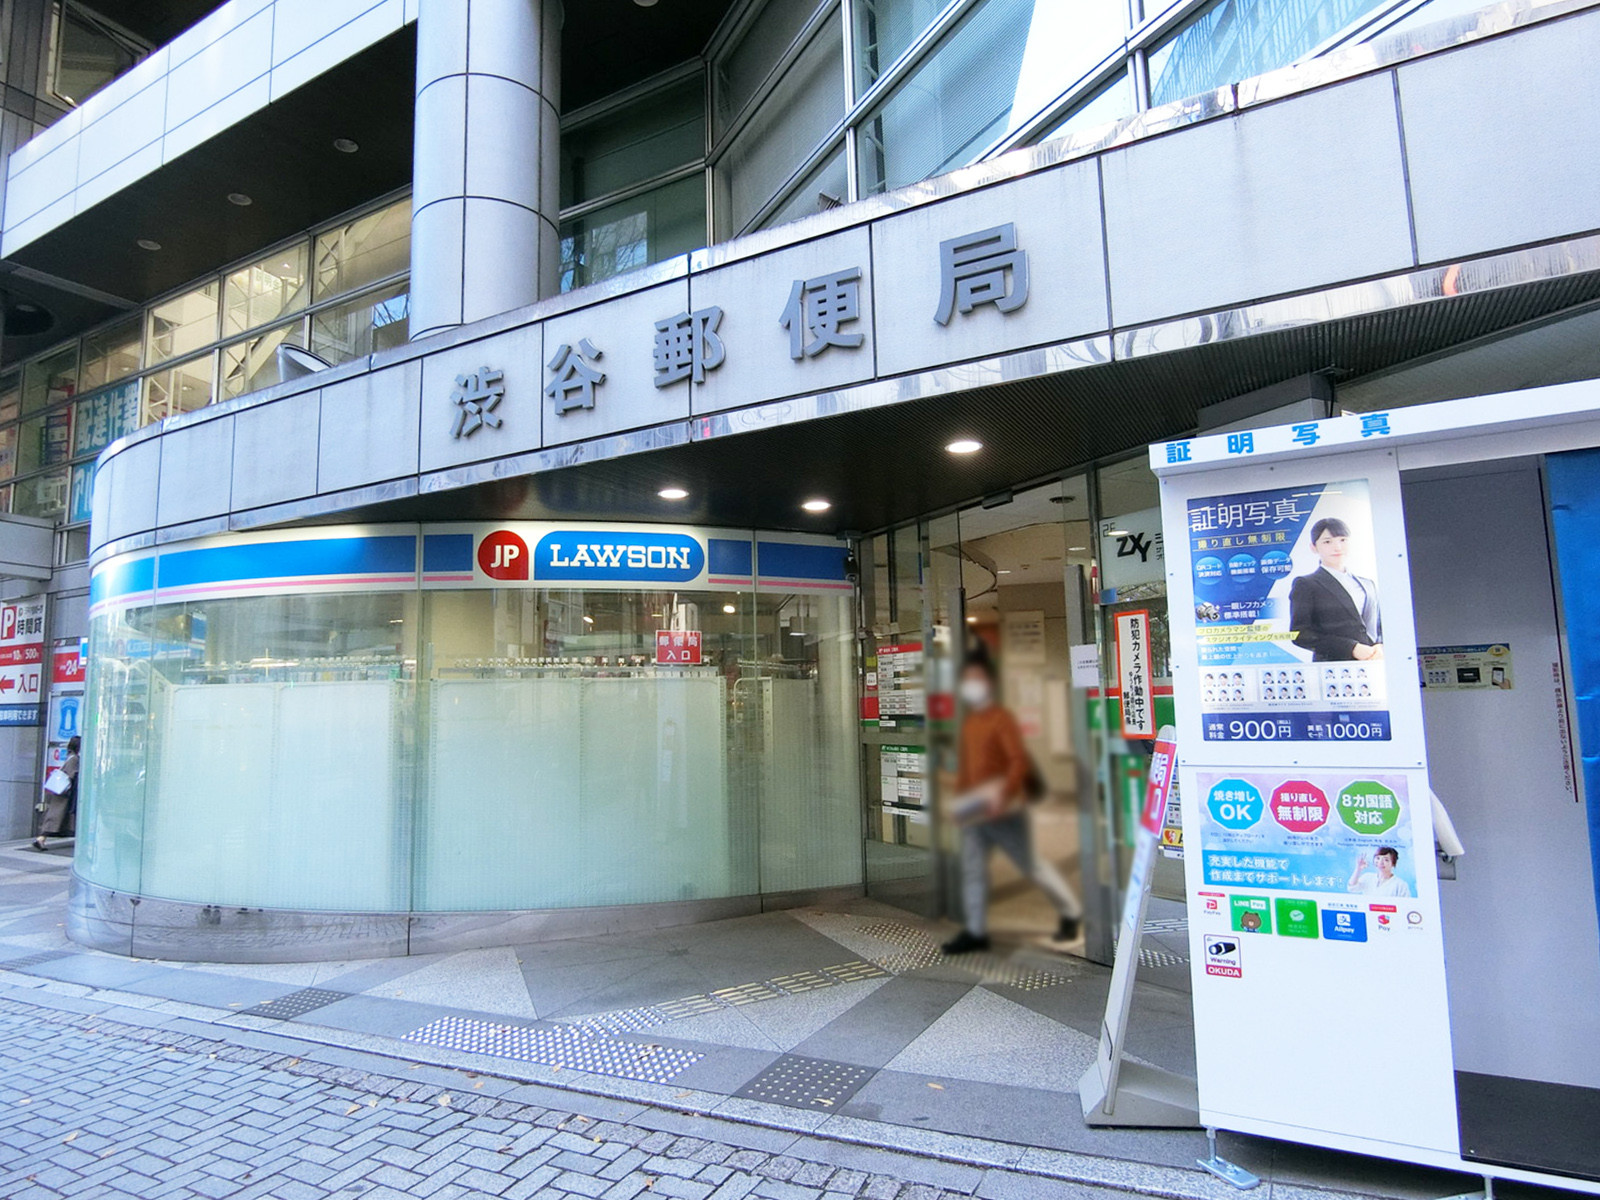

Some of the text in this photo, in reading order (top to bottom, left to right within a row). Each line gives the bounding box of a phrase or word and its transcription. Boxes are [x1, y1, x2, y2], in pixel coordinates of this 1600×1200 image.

[449, 222, 1030, 439] 渋谷郵便局
[1166, 412, 1391, 464] 証明写真
[1191, 498, 1300, 533] 証明写真
[1116, 532, 1152, 562] ZXY
[490, 544, 520, 568] JP
[550, 544, 691, 569] LAWSON
[2, 608, 14, 639] P
[658, 635, 698, 647] 郵便局
[666, 650, 691, 660] 入口
[1130, 618, 1145, 731] 防犯カメラ作動中です
[18, 673, 39, 694] 入口
[1229, 720, 1291, 740] 900円
[1326, 722, 1382, 739] 1000円
[1213, 789, 1256, 802] 焼き増し
[1280, 792, 1318, 803] 撮り直し
[1342, 793, 1394, 809] 8カ国語
[1219, 803, 1252, 821] OK
[1277, 805, 1325, 822] 無制限
[1354, 810, 1383, 825] 対応
[1208, 854, 1290, 870] 充実した機能で
[1210, 956, 1237, 966] Warning
[1208, 965, 1240, 977] OKUDA
